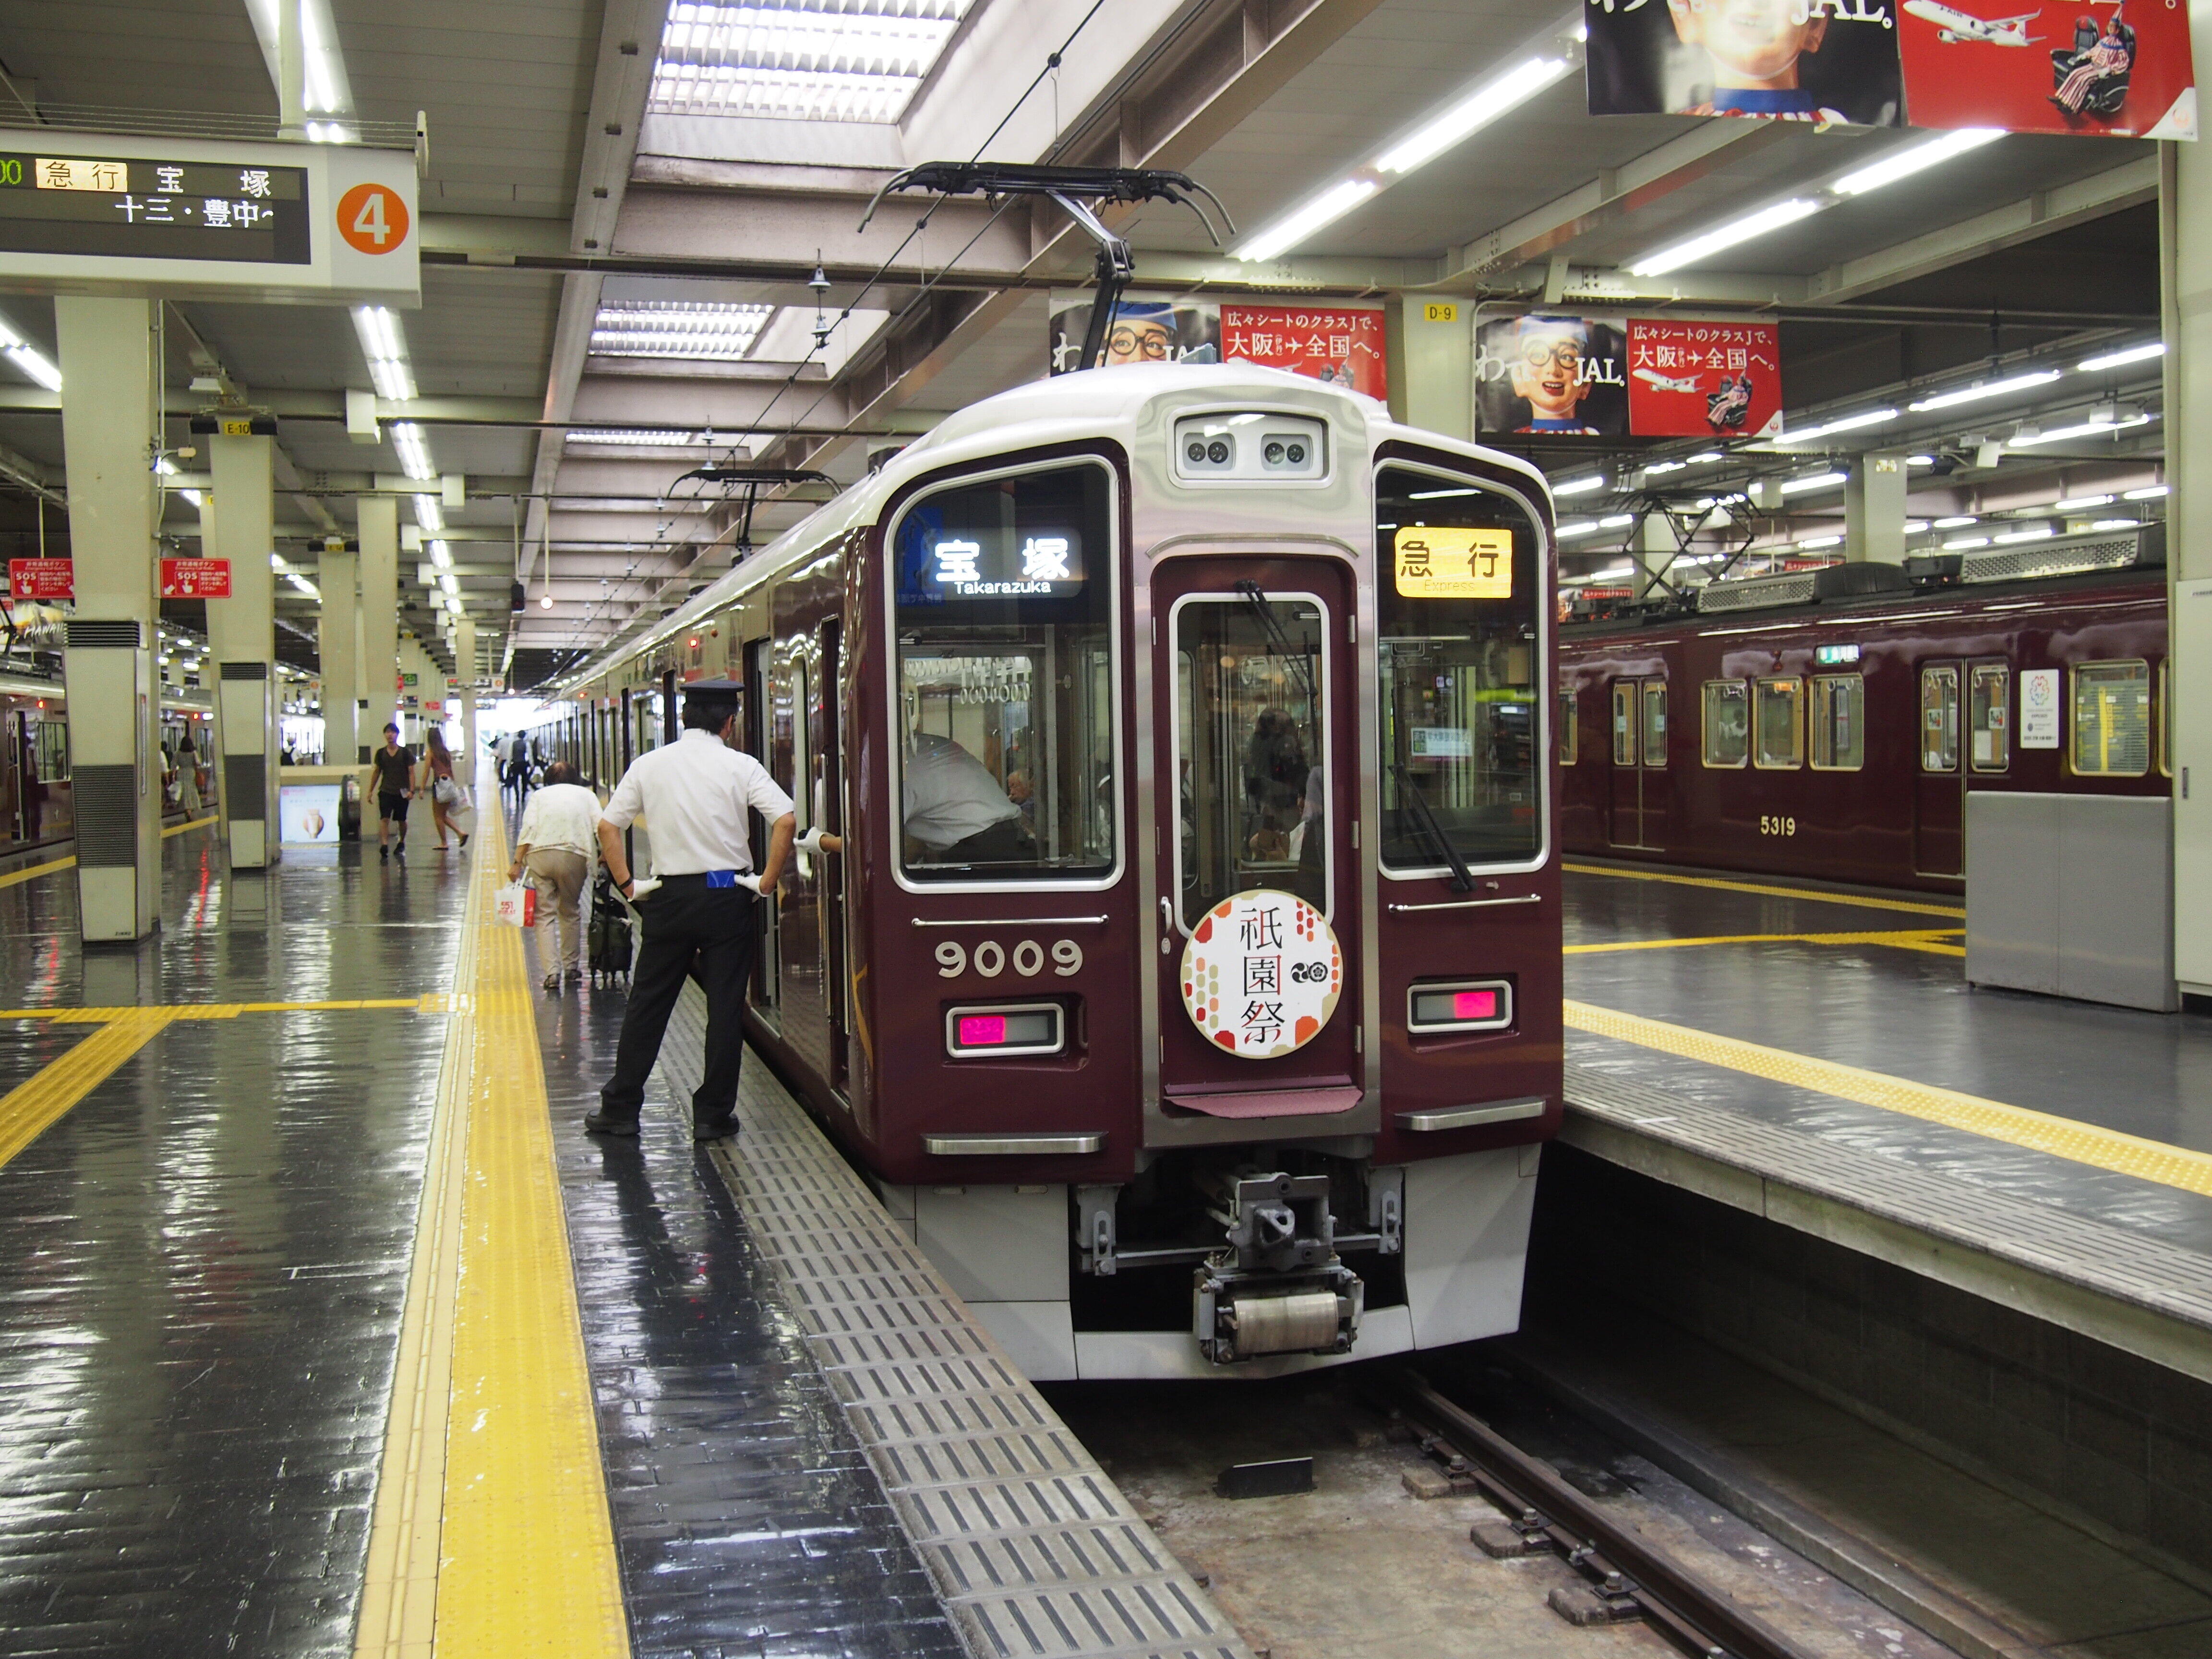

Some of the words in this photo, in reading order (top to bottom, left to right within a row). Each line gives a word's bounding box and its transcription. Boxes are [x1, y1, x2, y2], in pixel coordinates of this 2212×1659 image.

[46, 161, 119, 190] 急行
[157, 166, 272, 197] 宝塚
[353, 193, 391, 245] 4
[1228, 312, 1378, 332] 広々シートのクラスJで、
[1430, 308, 1452, 321] D-9
[1227, 331, 1274, 356] 大阪
[1306, 334, 1380, 359] 全国へ。
[1634, 325, 1772, 346] 広々シートのクラスJで、
[1633, 345, 1677, 367] 大阪
[1705, 347, 1775, 371] 全国へ。
[1573, 357, 1625, 387] JAL。
[228, 423, 249, 434] E-10
[935, 537, 1070, 582] 宝塚
[1401, 541, 1499, 577] 急行
[16, 572, 36, 580] SOS
[178, 572, 197, 580] SOS
[954, 581, 1051, 595] Takarazuka
[1424, 580, 1476, 593] Express
[1761, 815, 1796, 836] 5319
[934, 939, 1083, 978] 9009
[1240, 906, 1285, 1045] 祇園祭
